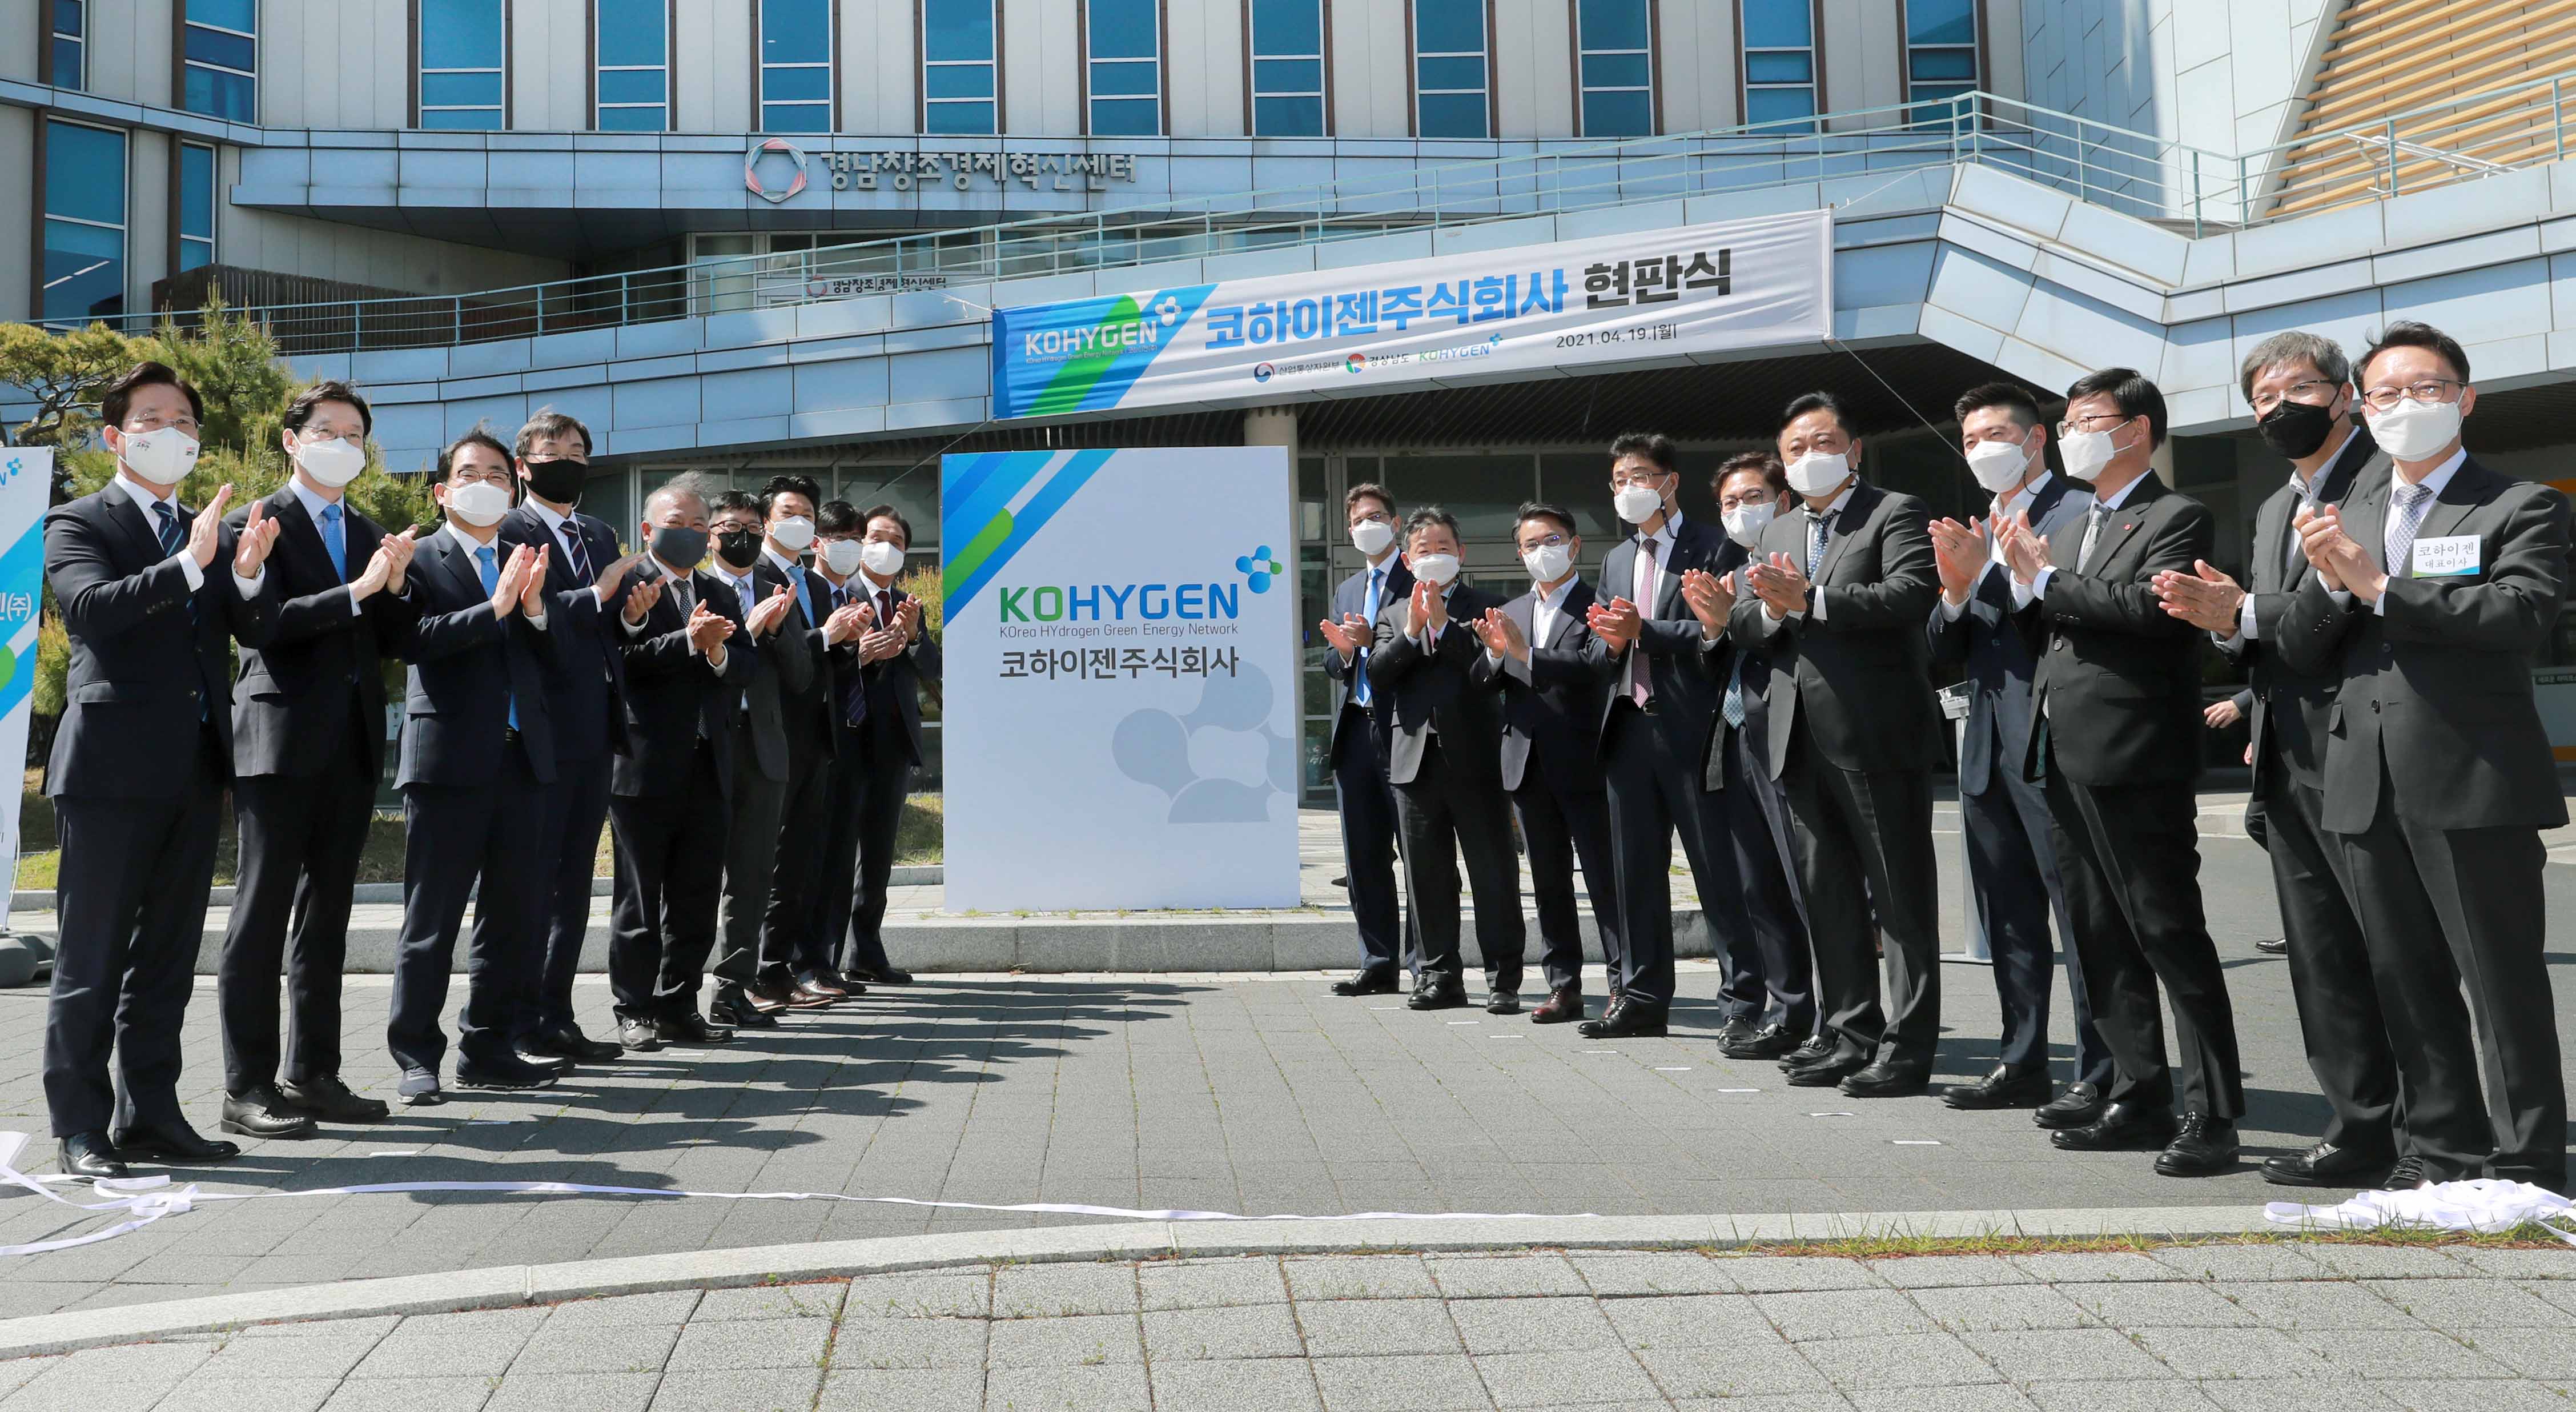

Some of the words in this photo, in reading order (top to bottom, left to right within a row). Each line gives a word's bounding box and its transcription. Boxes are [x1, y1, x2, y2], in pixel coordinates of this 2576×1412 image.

[821, 151, 1136, 191] 경남창조경제혁신센터
[1205, 268, 1569, 350] 코하이젠주식회사
[1584, 248, 1731, 310] 현판식
[1026, 320, 1158, 356] KOHYGEN
[1369, 352, 1410, 367] 경상남도
[1418, 344, 1490, 362] KOHYGEN
[1278, 360, 1340, 376] 산업통상자원부
[2418, 541, 2474, 556] 코하이젠
[2425, 557, 2468, 568] 대표이사
[1000, 583, 1238, 623] KOHYGEN
[1000, 626, 1036, 638] KOrea
[1040, 625, 1100, 639] HYdrogen
[1104, 623, 1138, 636] Green
[1143, 623, 1184, 638] Energy
[1188, 623, 1238, 635] Network
[999, 646, 1239, 680] 코하이젠주식회사
